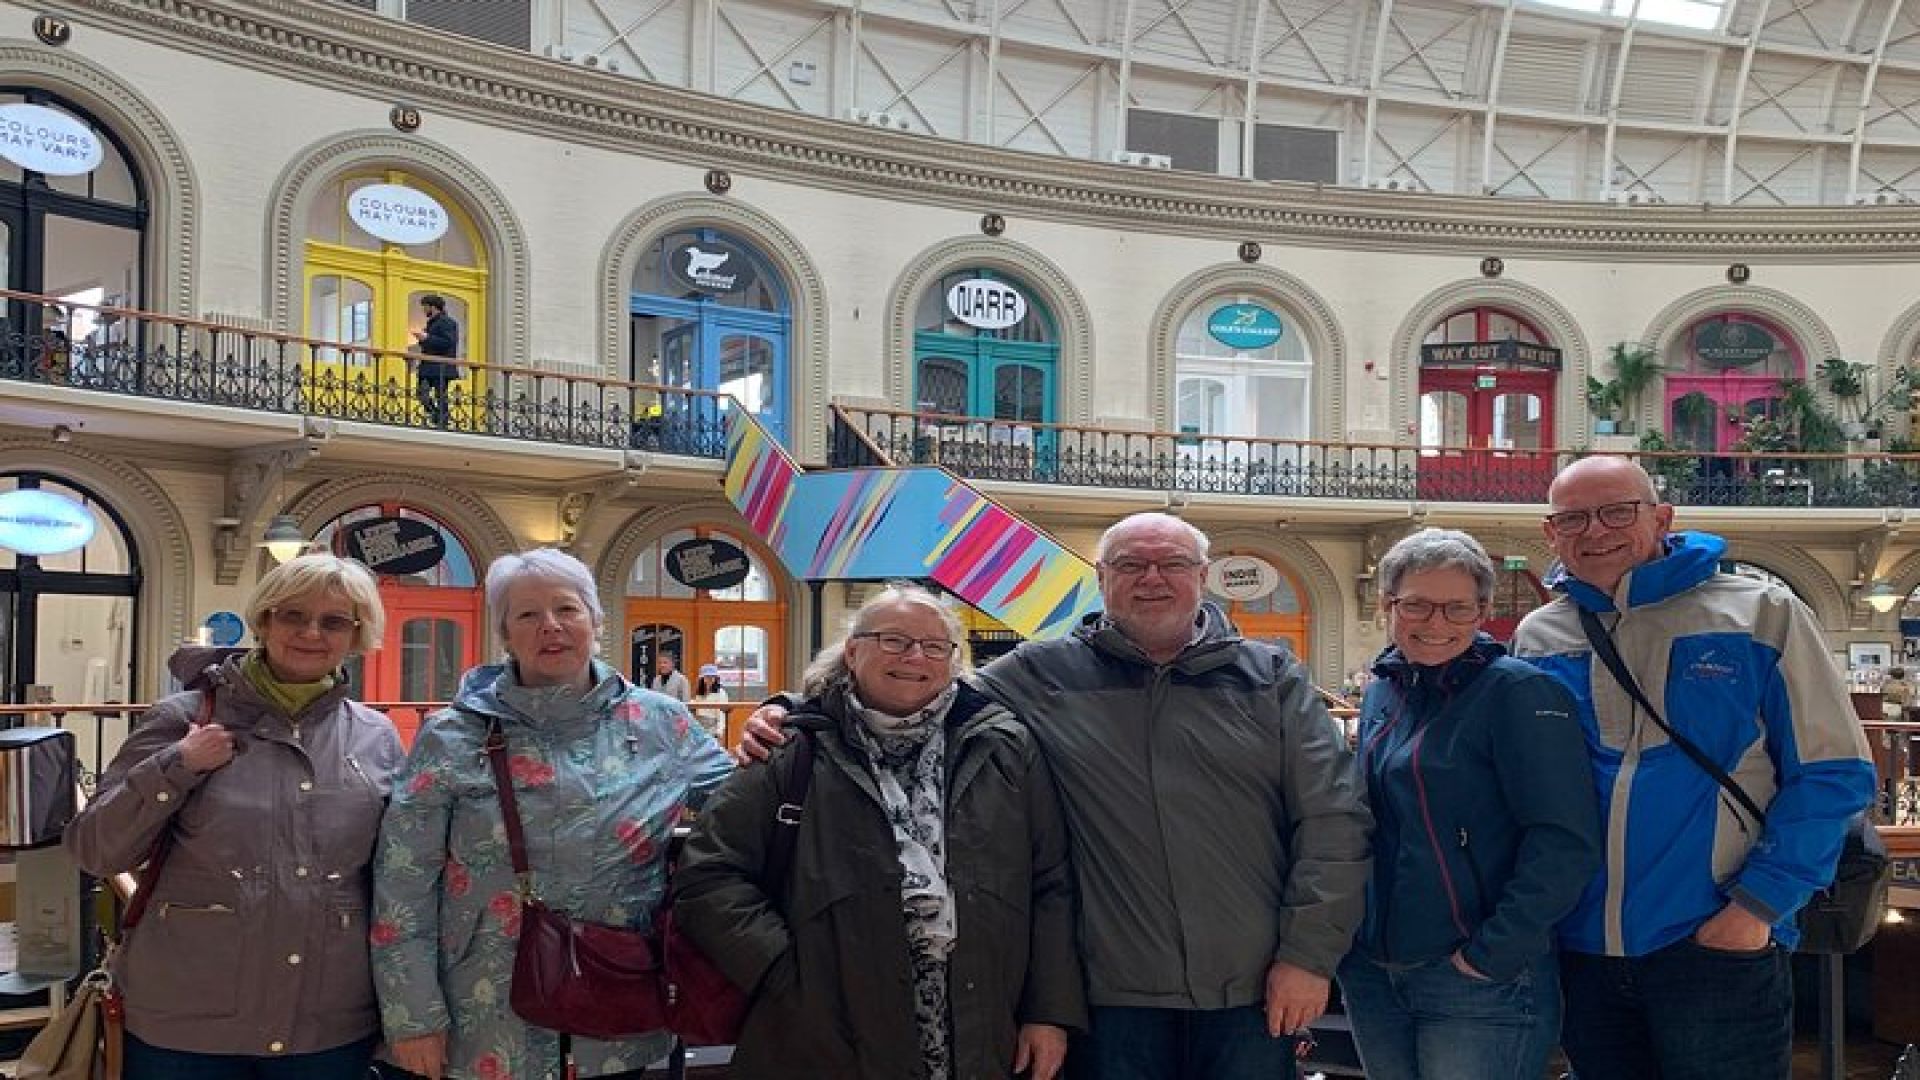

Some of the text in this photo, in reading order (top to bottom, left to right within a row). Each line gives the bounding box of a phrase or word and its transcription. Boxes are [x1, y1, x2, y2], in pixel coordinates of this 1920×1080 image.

[44, 17, 66, 37] 17
[397, 109, 417, 125] 16
[0, 116, 92, 149] COLOURS
[0, 132, 90, 160] MAY VARY
[359, 197, 438, 219] COLOURS
[359, 208, 438, 231] MAY VARY
[957, 286, 1017, 322] NARR
[1431, 344, 1498, 361] WAY OUT
[1518, 347, 1557, 364] WAY OUT
